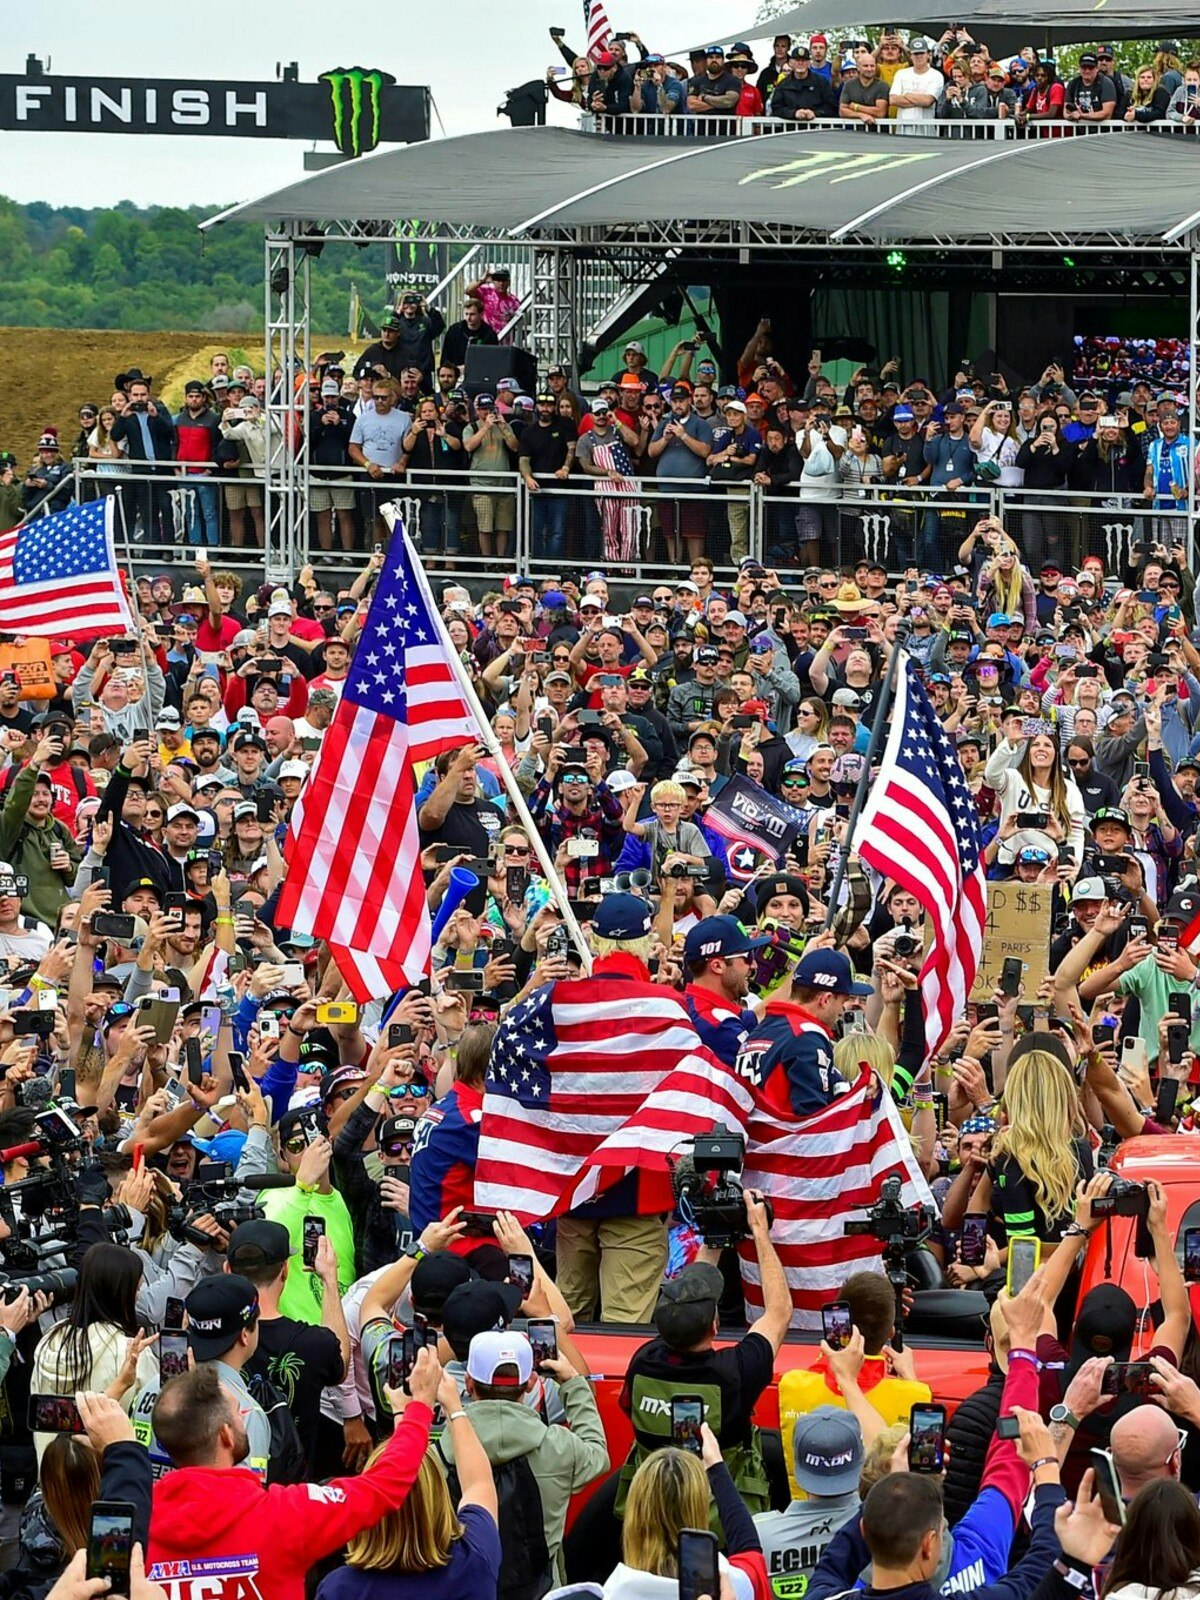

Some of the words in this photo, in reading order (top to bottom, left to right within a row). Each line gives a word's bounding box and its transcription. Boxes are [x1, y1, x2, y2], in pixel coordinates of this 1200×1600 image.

[15, 85, 268, 127] FINISH
[700, 940, 723, 956] 101
[1000, 941, 1032, 954] PARTS
[813, 972, 838, 987] 102
[148, 1559, 193, 1581] AMA
[203, 1560, 240, 1571] MOTOCROSS
[241, 1556, 260, 1569] TEAM
[779, 1583, 804, 1597] 122
